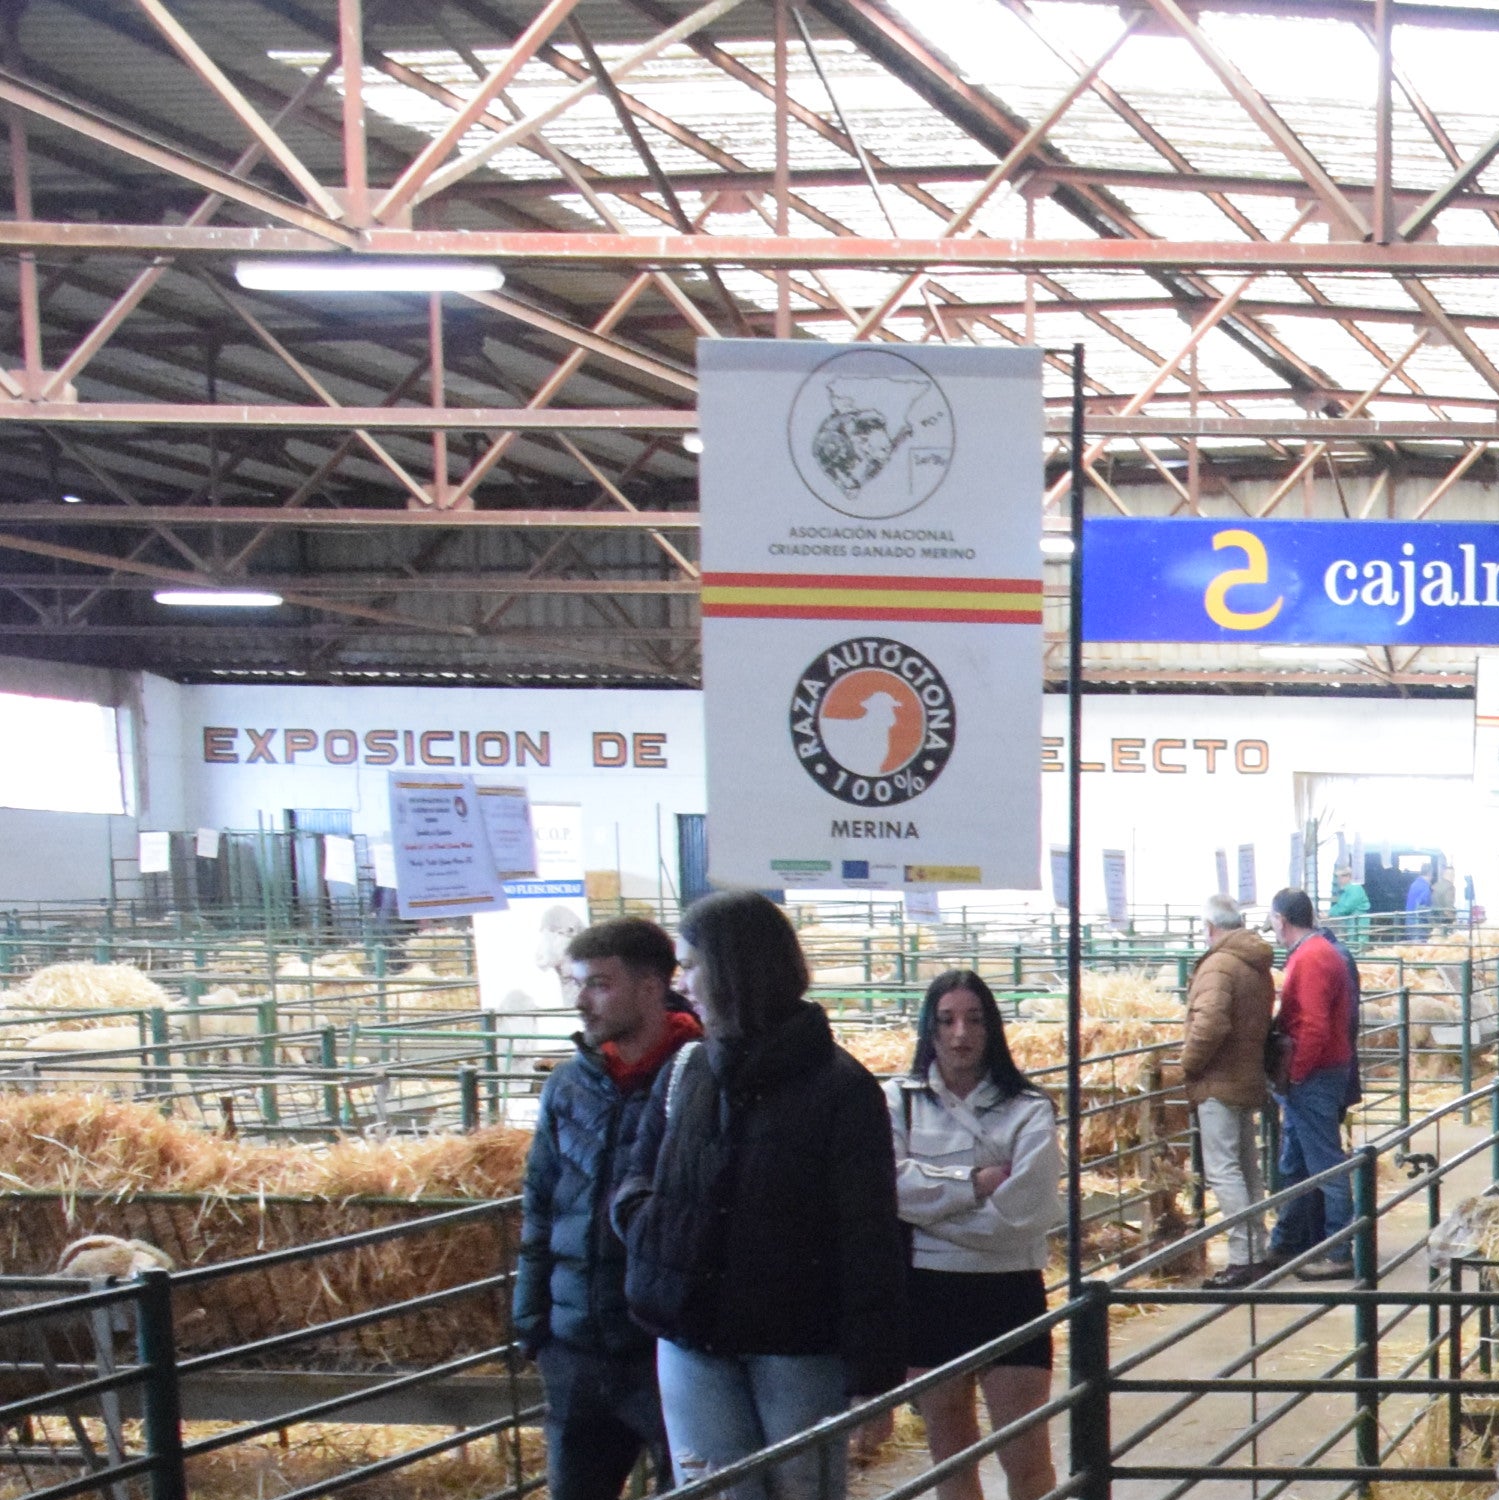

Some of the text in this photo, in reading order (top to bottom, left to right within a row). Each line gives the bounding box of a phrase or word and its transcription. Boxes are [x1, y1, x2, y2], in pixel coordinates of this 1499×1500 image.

[788, 525, 955, 543] ASOCIACIÓN NACIONAL
[767, 542, 976, 560] CRIADORES GANADO MERINO
[792, 640, 951, 760] RAZA AUTÓCTONA
[202, 725, 1270, 775] EXPOSICION DE EECTO
[831, 768, 926, 803] 100%
[830, 818, 920, 841] MERINA
